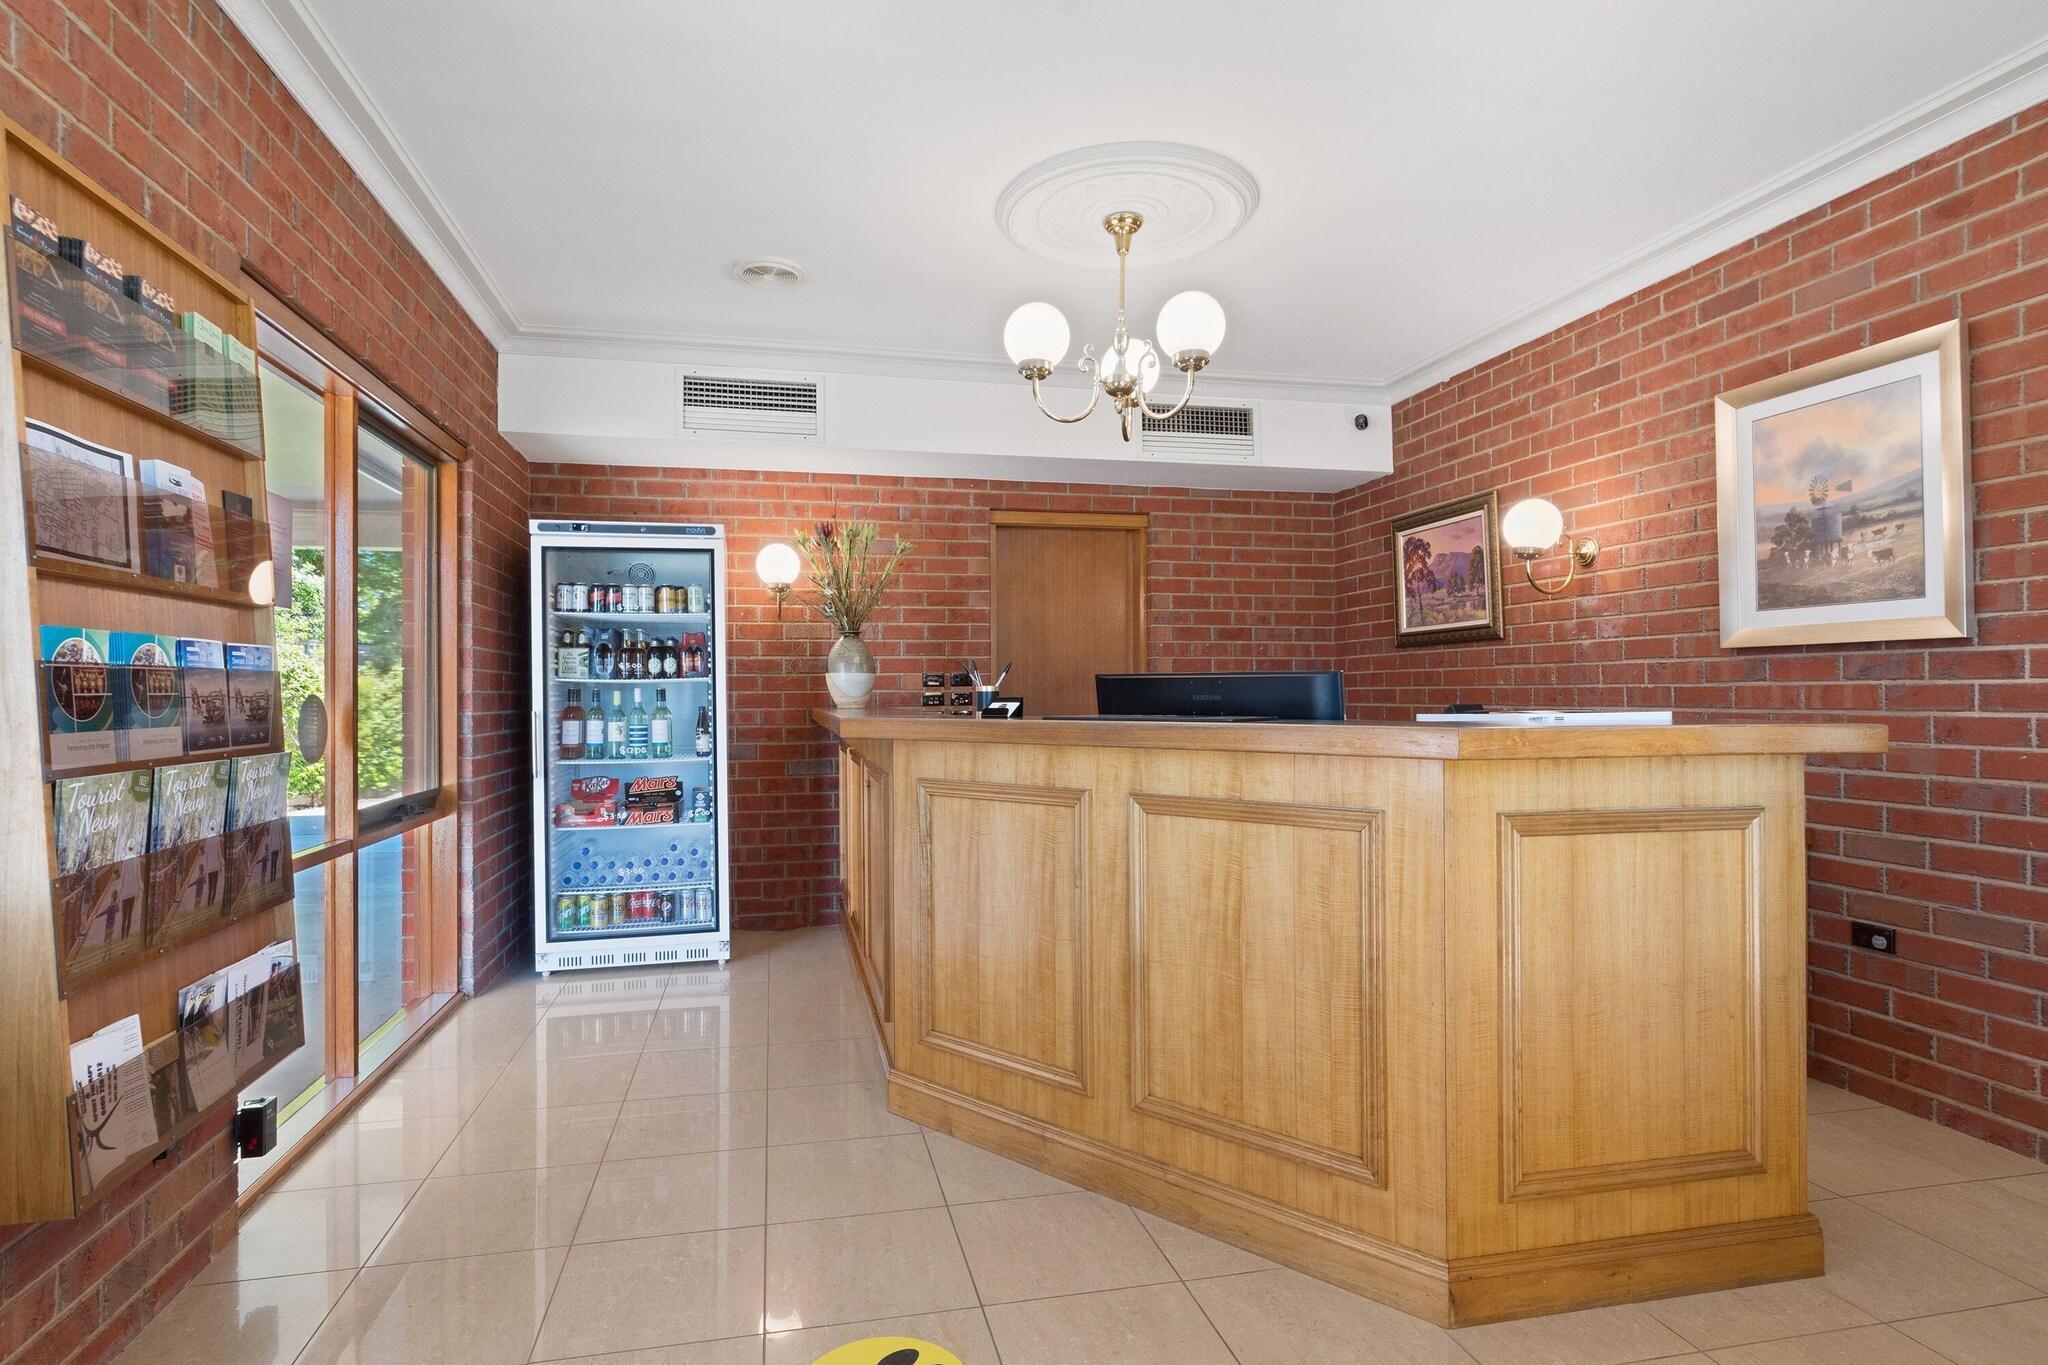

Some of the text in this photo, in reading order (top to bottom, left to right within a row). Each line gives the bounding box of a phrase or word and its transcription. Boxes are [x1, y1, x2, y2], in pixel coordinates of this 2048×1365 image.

[255, 657, 270, 666] Region
[167, 766, 210, 796] Tourist
[241, 757, 276, 783] Tourist
[68, 777, 126, 813] Tourist
[246, 779, 272, 802] News
[583, 777, 608, 792] KitKat
[630, 776, 677, 792] Mars
[174, 792, 205, 817] News
[79, 806, 119, 838] News
[625, 809, 674, 825] Mars
